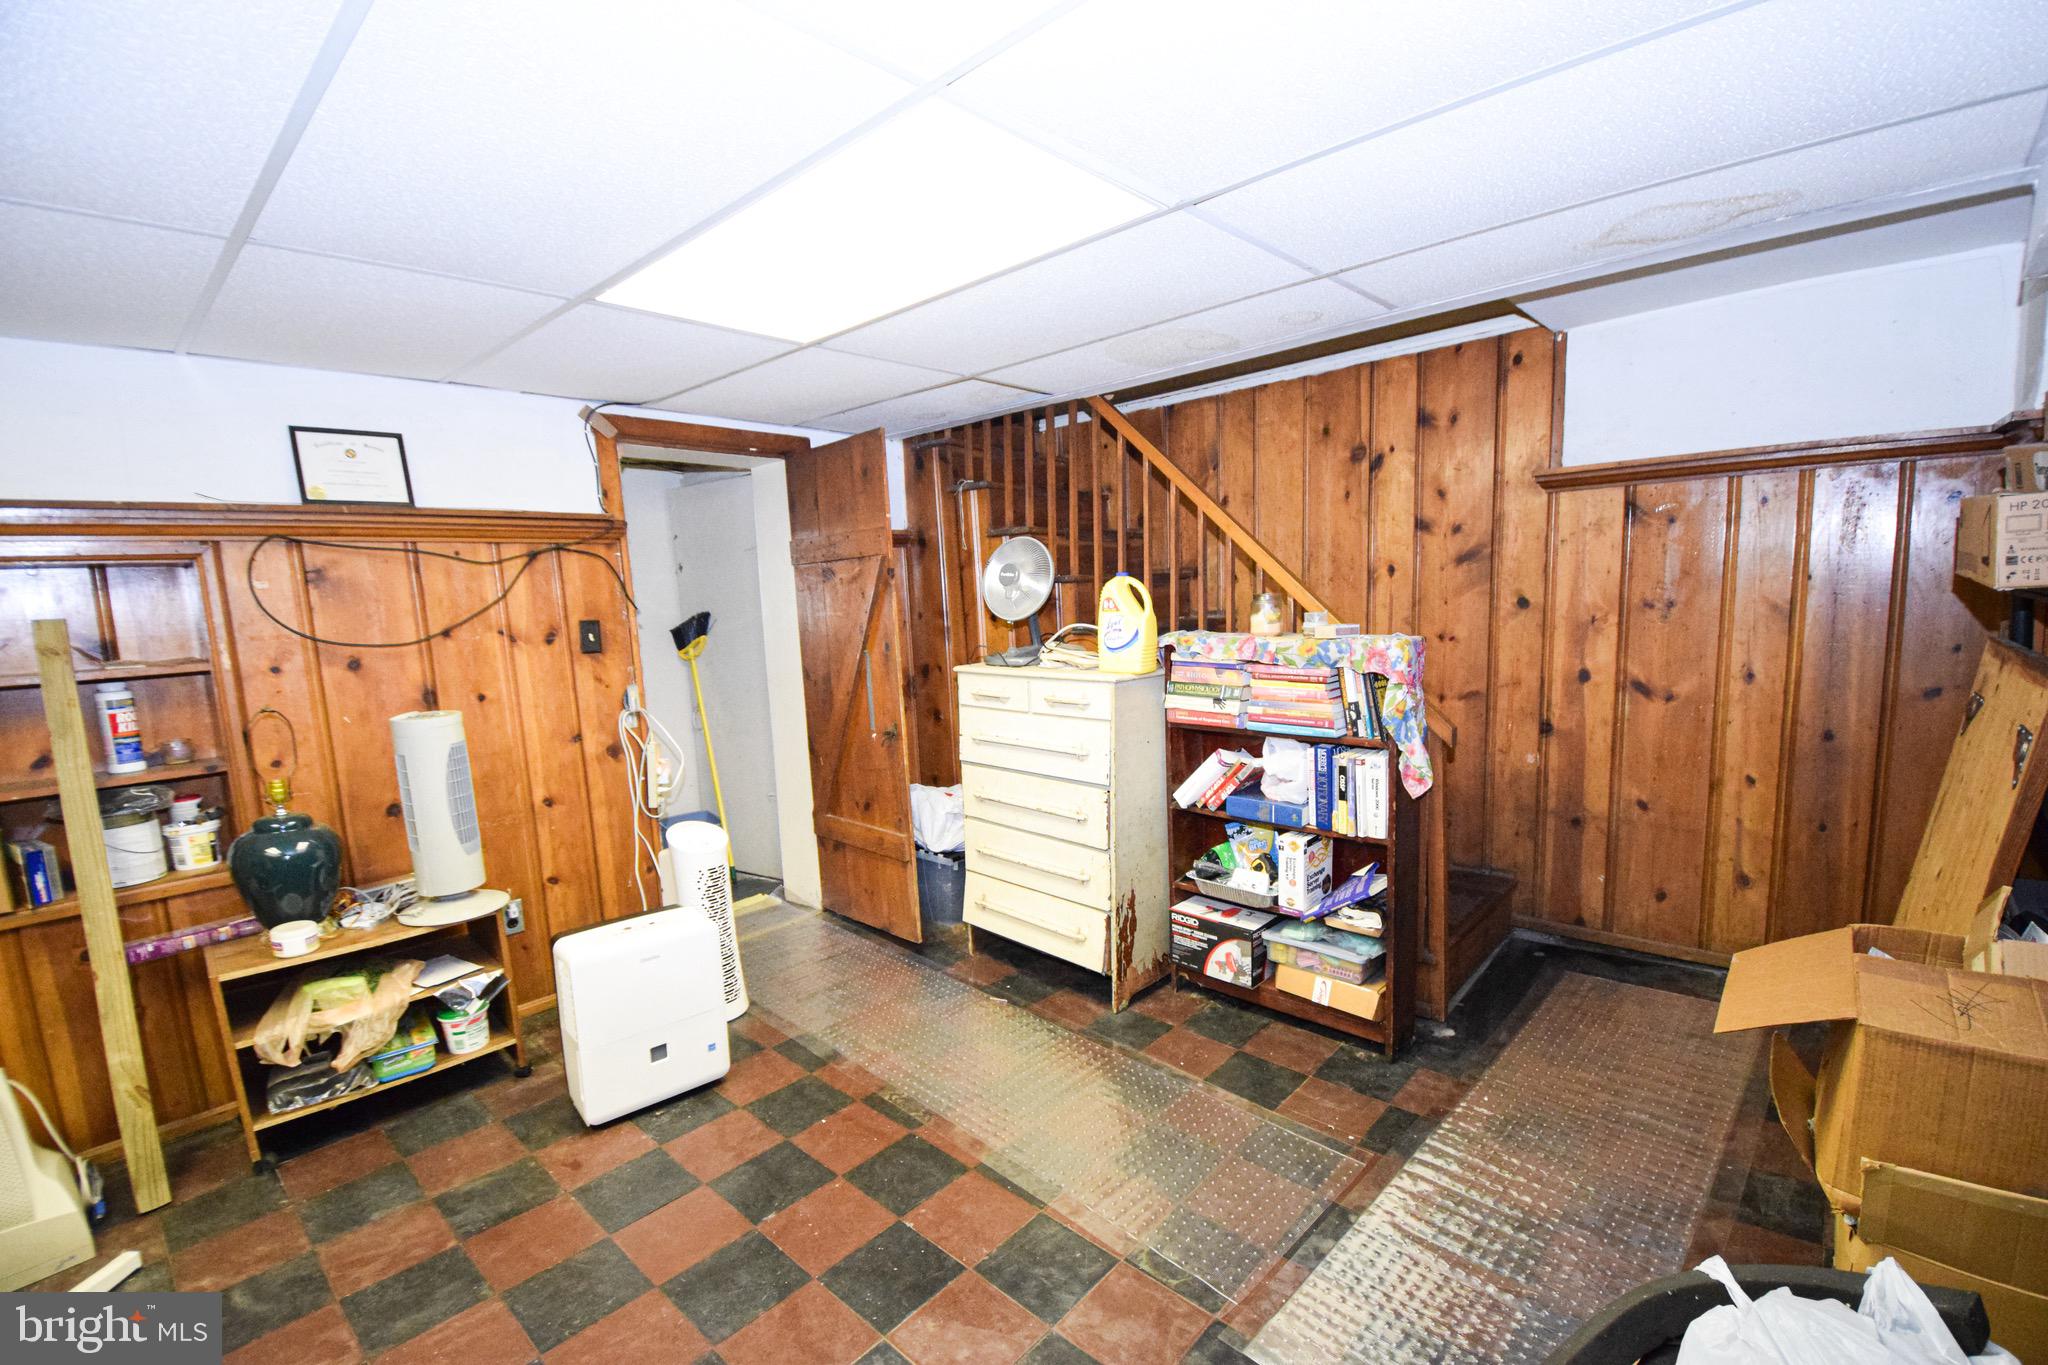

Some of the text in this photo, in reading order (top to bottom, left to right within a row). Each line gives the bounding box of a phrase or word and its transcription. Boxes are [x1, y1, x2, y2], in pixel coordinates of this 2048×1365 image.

[2009, 501, 2028, 512] HP
[1317, 771, 1330, 825] DICTIONARY
[1306, 867, 1326, 882] Exchange
[1306, 877, 1320, 888] Server
[1171, 912, 1200, 926] RIDGID
